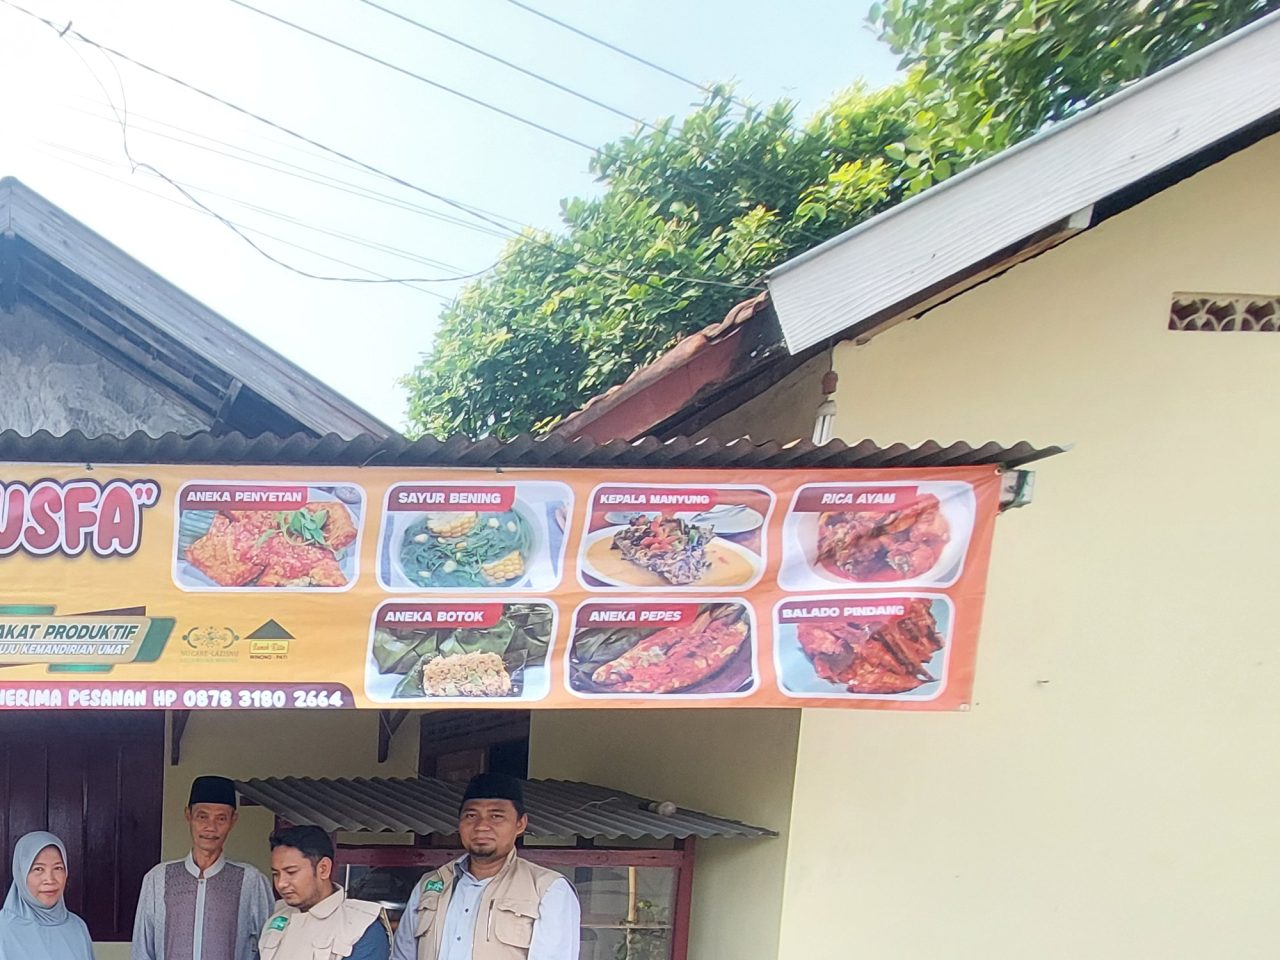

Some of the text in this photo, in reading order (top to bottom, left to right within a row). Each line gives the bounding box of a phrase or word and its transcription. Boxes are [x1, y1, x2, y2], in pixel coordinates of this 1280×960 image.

[186, 491, 303, 503] ANEKA PENYETAN
[398, 492, 502, 504] SAYUR BENING
[600, 493, 710, 505] KEPALA MANYUNG
[821, 493, 896, 505] RICA AYAM
[384, 611, 485, 622] ANEKA BOTOK
[589, 610, 682, 622] ANEKA PEPES
[782, 605, 905, 619] BALADO PINDANG
[43, 623, 139, 641] PRODUKTIF
[20, 643, 97, 656] KEMANDIRIAN
[97, 643, 130, 656] UMAT
[68, 689, 148, 708] PESANAN
[152, 689, 178, 708] HP
[182, 689, 233, 708] 0878
[238, 689, 287, 708] 3180
[293, 689, 345, 708] 2664
